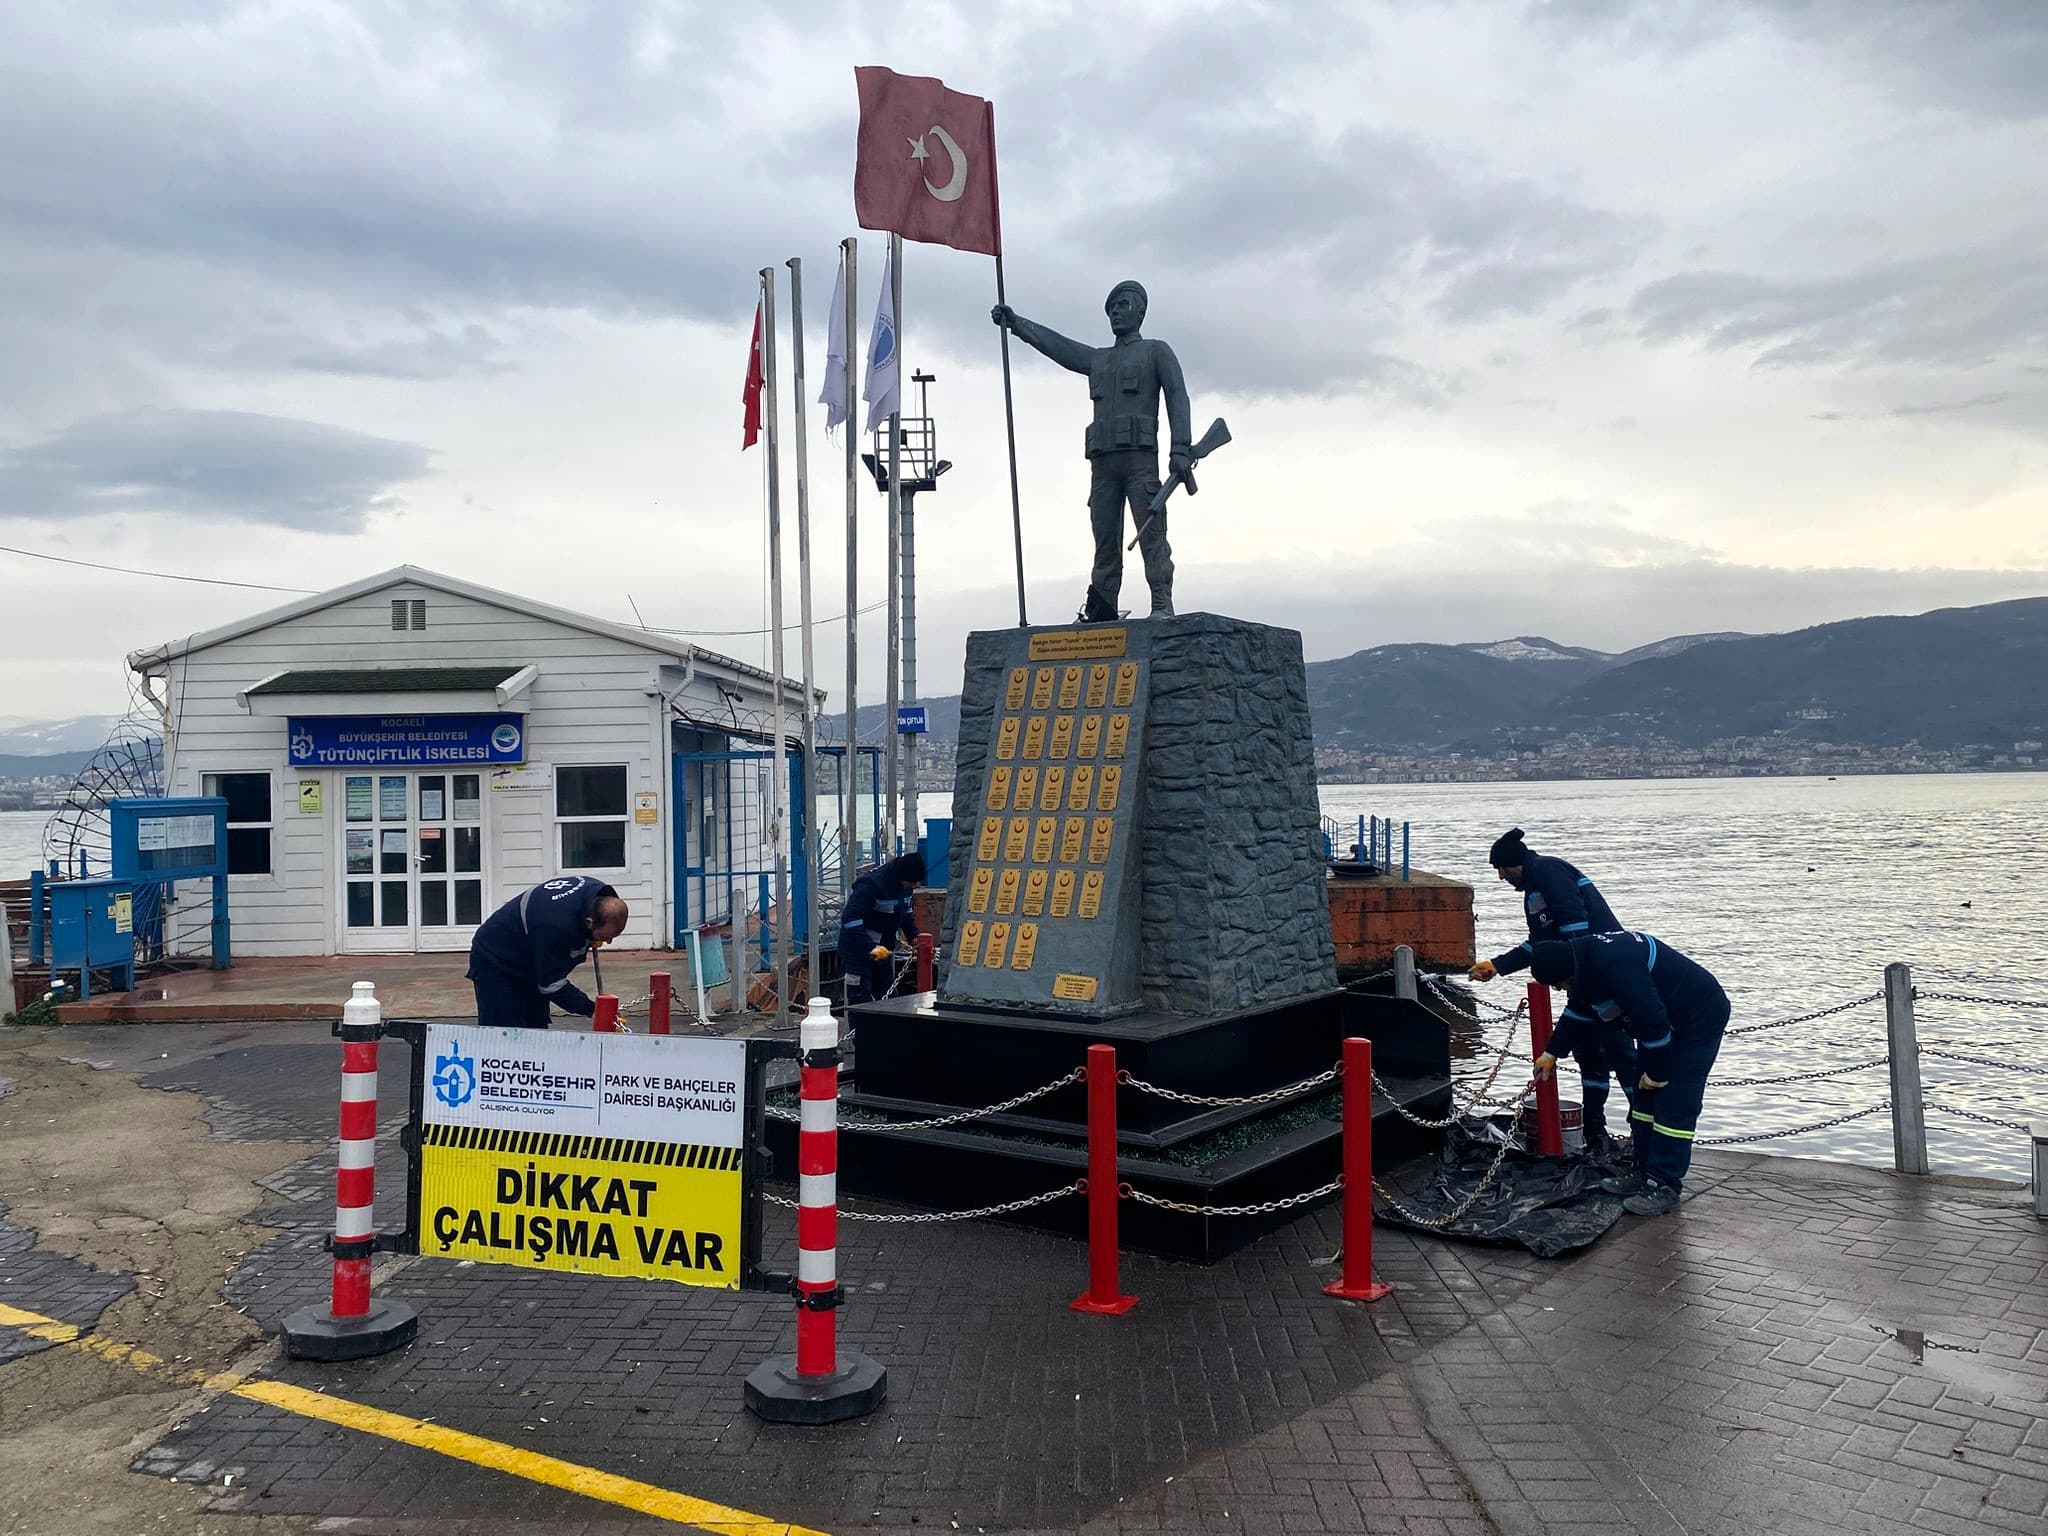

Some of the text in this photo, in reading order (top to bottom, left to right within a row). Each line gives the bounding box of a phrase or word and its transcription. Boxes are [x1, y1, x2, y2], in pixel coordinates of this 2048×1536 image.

[381, 717, 425, 727] KOCAELİ
[339, 730, 468, 743] BÜYÜKŞEHİR BELEDİYESİ
[318, 747, 490, 763] TÜTÜNÇİFTLİK İSKELESİ
[481, 1057, 545, 1073] KOCAELİ
[481, 1071, 596, 1091] BÜYÜKŞEHİR
[604, 1074, 736, 1095] PARK VE BAHÇELER
[480, 1085, 567, 1102] BELEDİYESİ
[604, 1090, 736, 1113] DAİRESİ BAŞKANLIĞI
[522, 1106, 555, 1115] OLUYOR
[497, 1161, 657, 1218] DİKKAT
[433, 1206, 724, 1272] ÇALIŞMA VAR
